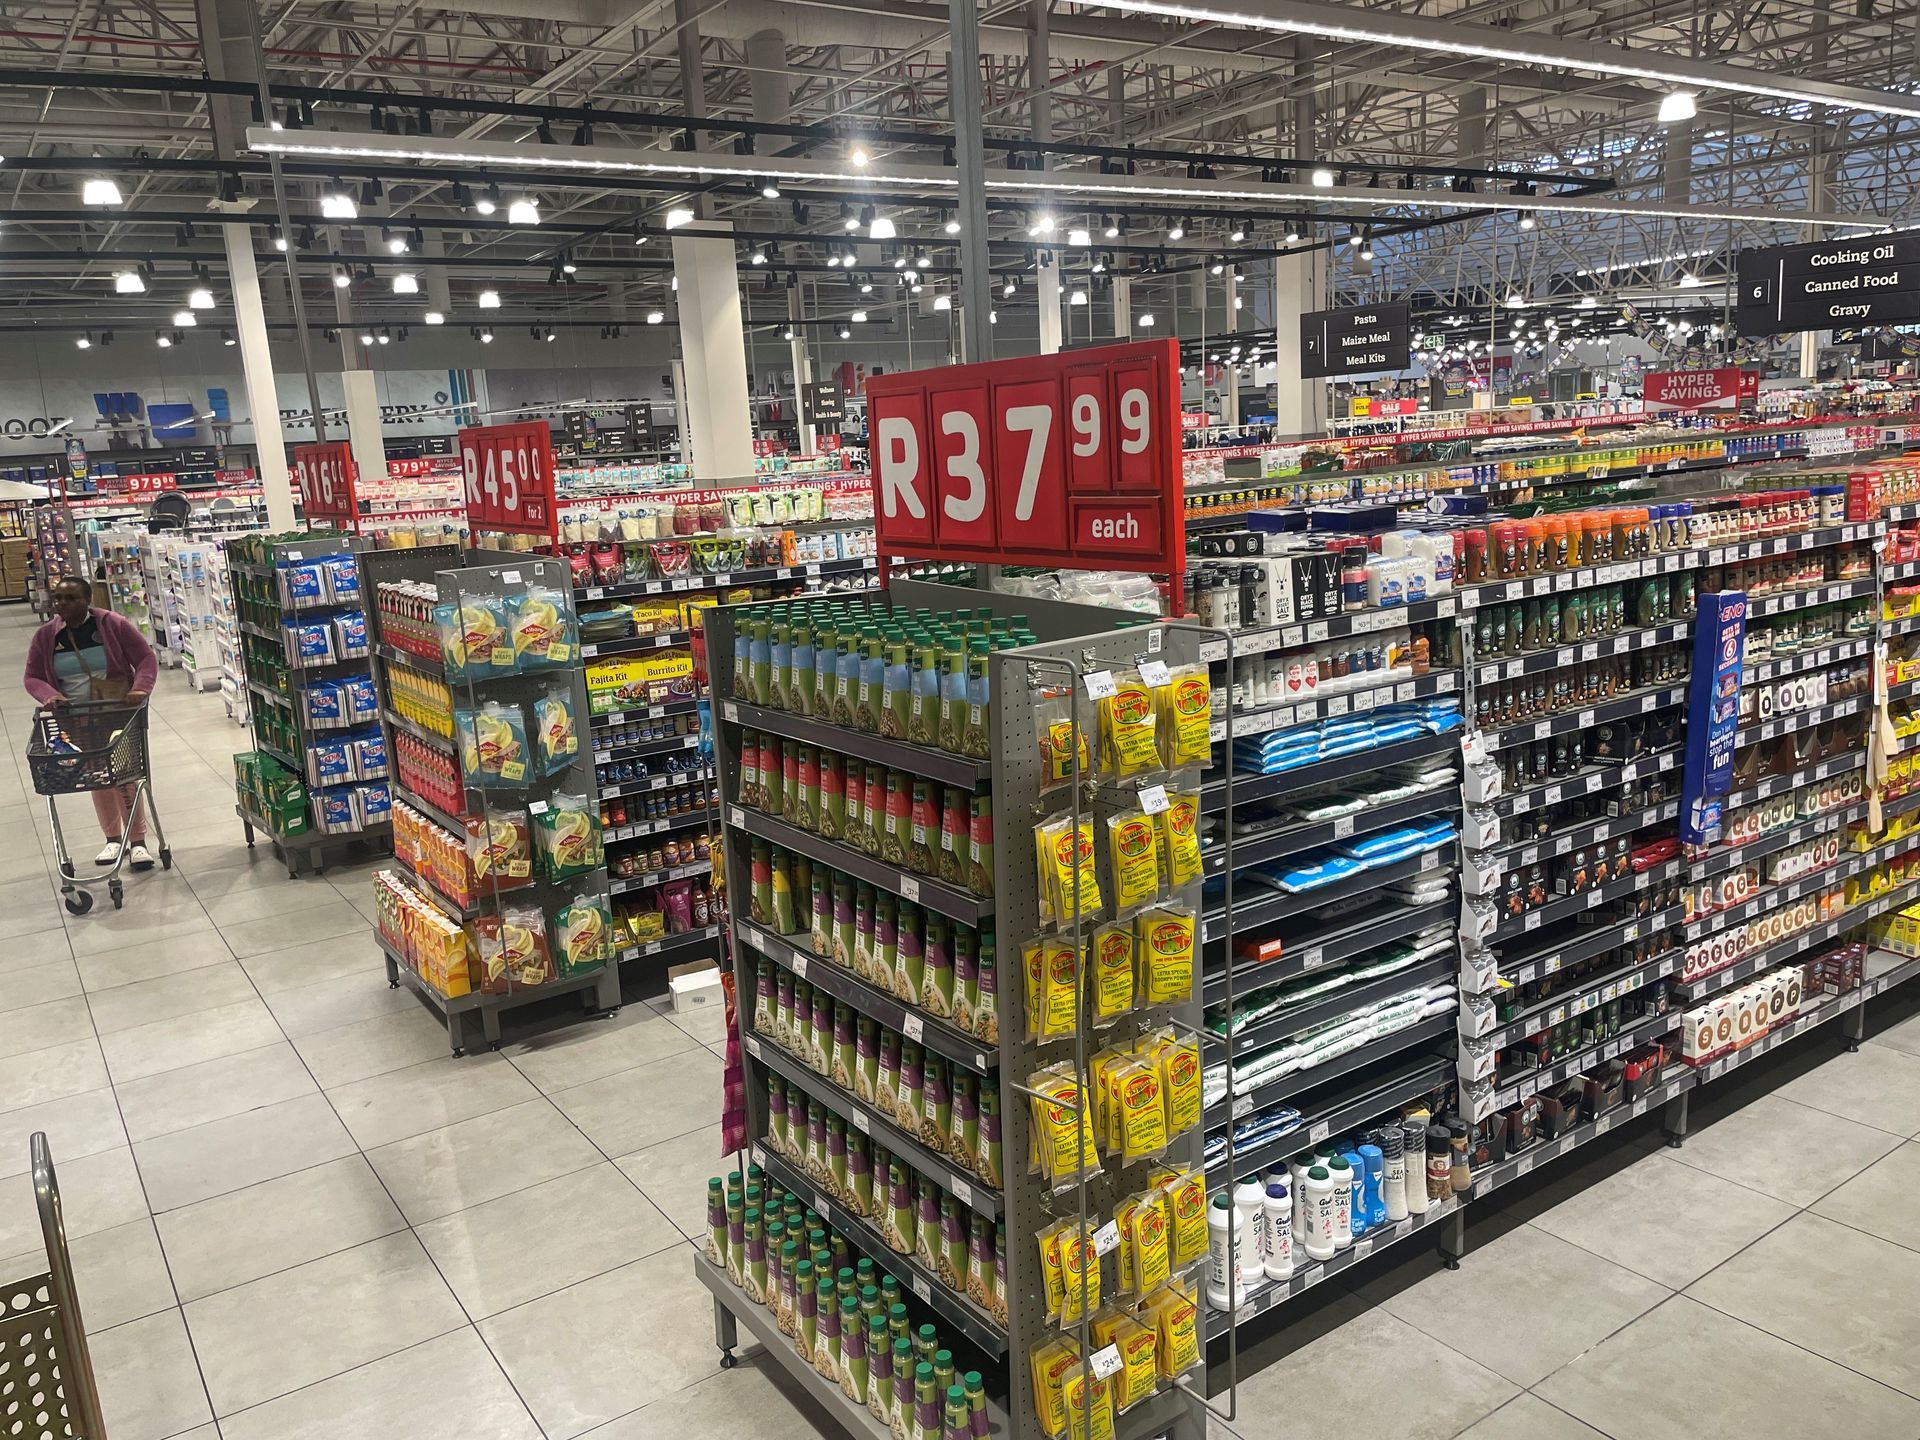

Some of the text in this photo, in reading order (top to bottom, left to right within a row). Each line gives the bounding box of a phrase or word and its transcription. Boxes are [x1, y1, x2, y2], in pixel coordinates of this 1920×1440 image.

[1811, 245, 1894, 266] Cooking Oil
[1805, 272, 1898, 293] Canned Food
[1753, 286, 1762, 298] 6
[1829, 304, 1871, 317] Gravy
[1354, 314, 1377, 325] Pasta
[1309, 341, 1314, 350] 7
[1342, 332, 1390, 347] Maize Meal
[1346, 353, 1386, 366] Meal Kits
[1667, 373, 1714, 387] HYPER
[1660, 385, 1721, 400] SAVINGS
[1381, 402, 1400, 411] SALE
[1182, 416, 1199, 425] SALE
[1187, 413, 1647, 459] HYPER SAVINGS HYPER HYPER SAVINGS HYPER SAVINGS HYPER SAVINGS HYPER SAVINGS HYPER SAVINGS HYPER SAVINGS HYPER SAVINGS
[569, 478, 872, 511] HYPER SAVINGS HYPER SAVINGS HYPER SAVINGS HYPER
[394, 511, 453, 523] SAVINGS
[528, 503, 537, 518] for
[1092, 512, 1138, 539] each
[1276, 606, 1289, 614] SALT
[1721, 602, 1745, 622] ENO
[550, 649, 567, 657] WRAPS
[647, 663, 688, 677] Burrito Kit
[1718, 656, 1739, 671] SECONDS
[590, 672, 627, 685] Fajita Kit
[1116, 697, 1142, 710] TAJ MAHAL
[1123, 740, 1137, 748] EXTRA
[1709, 731, 1734, 748] heartburn
[1709, 738, 1733, 757] stop the
[1713, 752, 1730, 770] fun
[504, 767, 521, 775] WRAPS
[1126, 868, 1153, 881] EXTRA SPECIAL
[1166, 930, 1185, 939] MAHAL
[1138, 1081, 1151, 1093] MAHAL
[1131, 1118, 1159, 1131] EXTRA SPECIAL
[1374, 1210, 1385, 1218] Table
[1277, 1229, 1291, 1237] SAL
